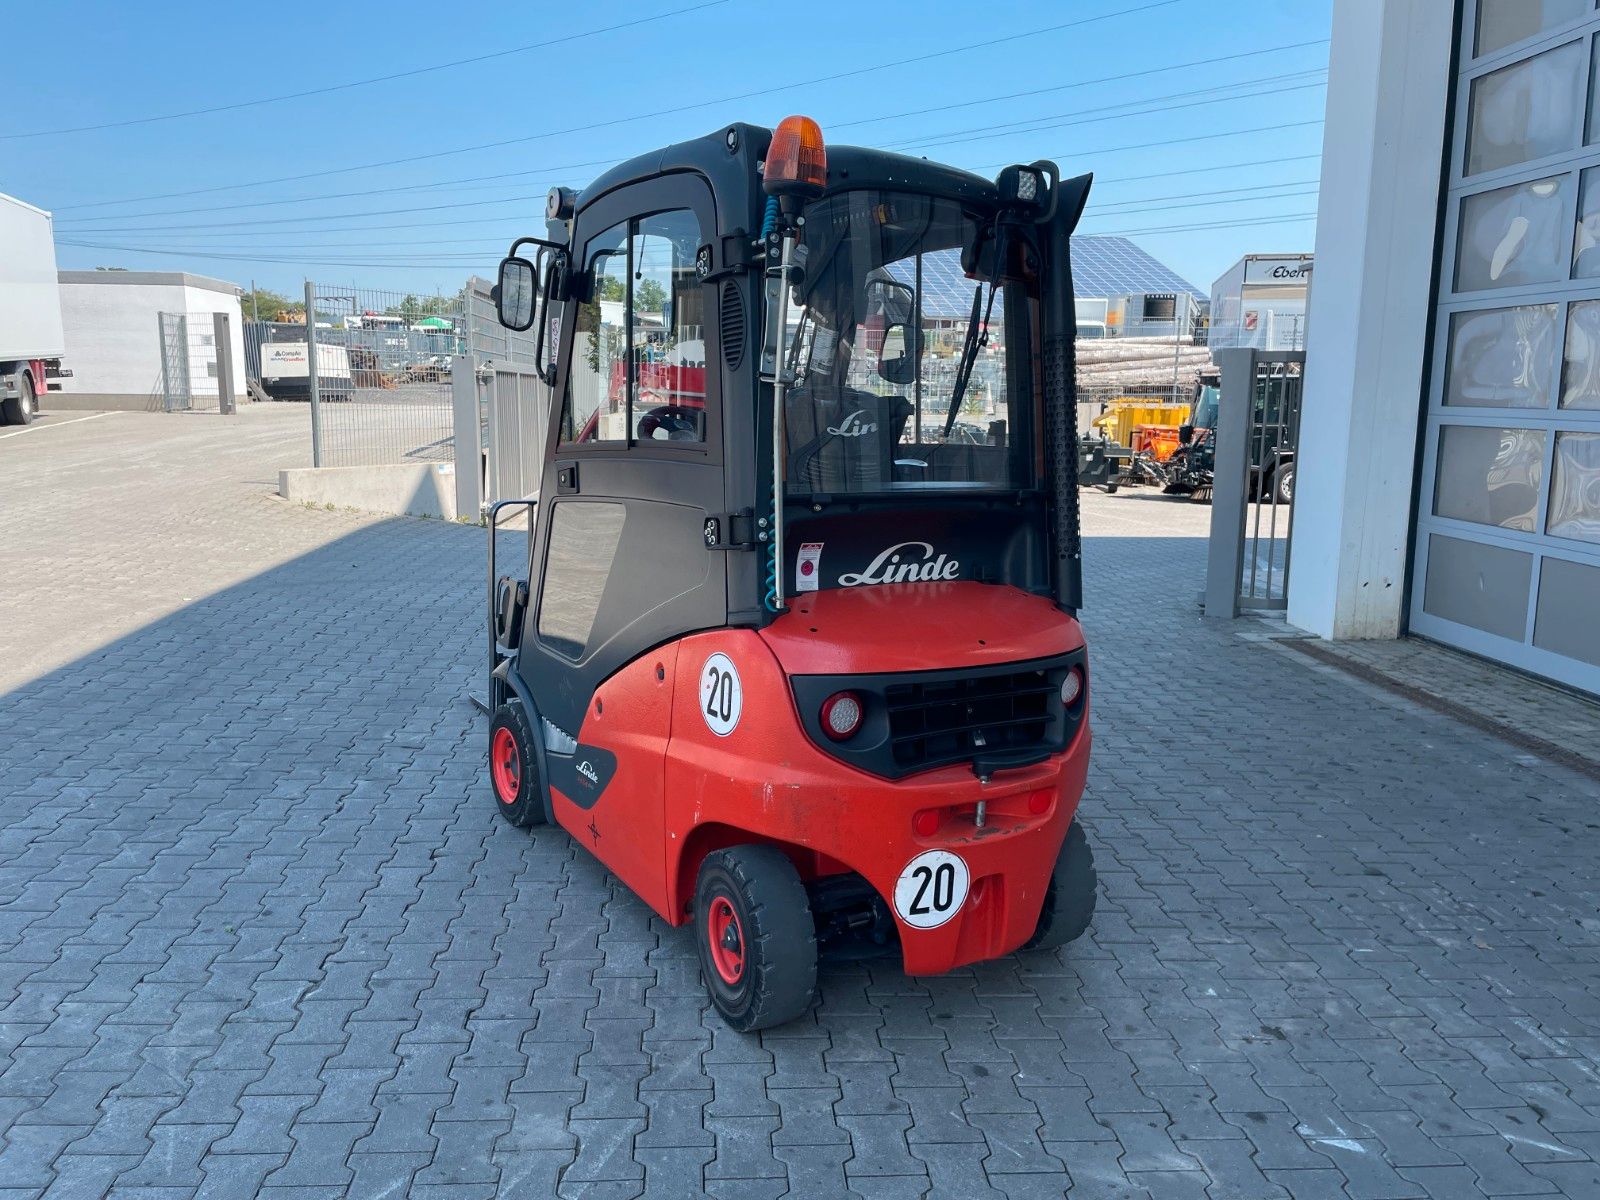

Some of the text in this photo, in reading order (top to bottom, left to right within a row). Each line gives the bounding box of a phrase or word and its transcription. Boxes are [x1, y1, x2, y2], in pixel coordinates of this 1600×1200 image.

[838, 541, 959, 586] Linde
[707, 666, 733, 722] 20
[575, 761, 599, 784] Linde
[909, 863, 955, 915] 20
